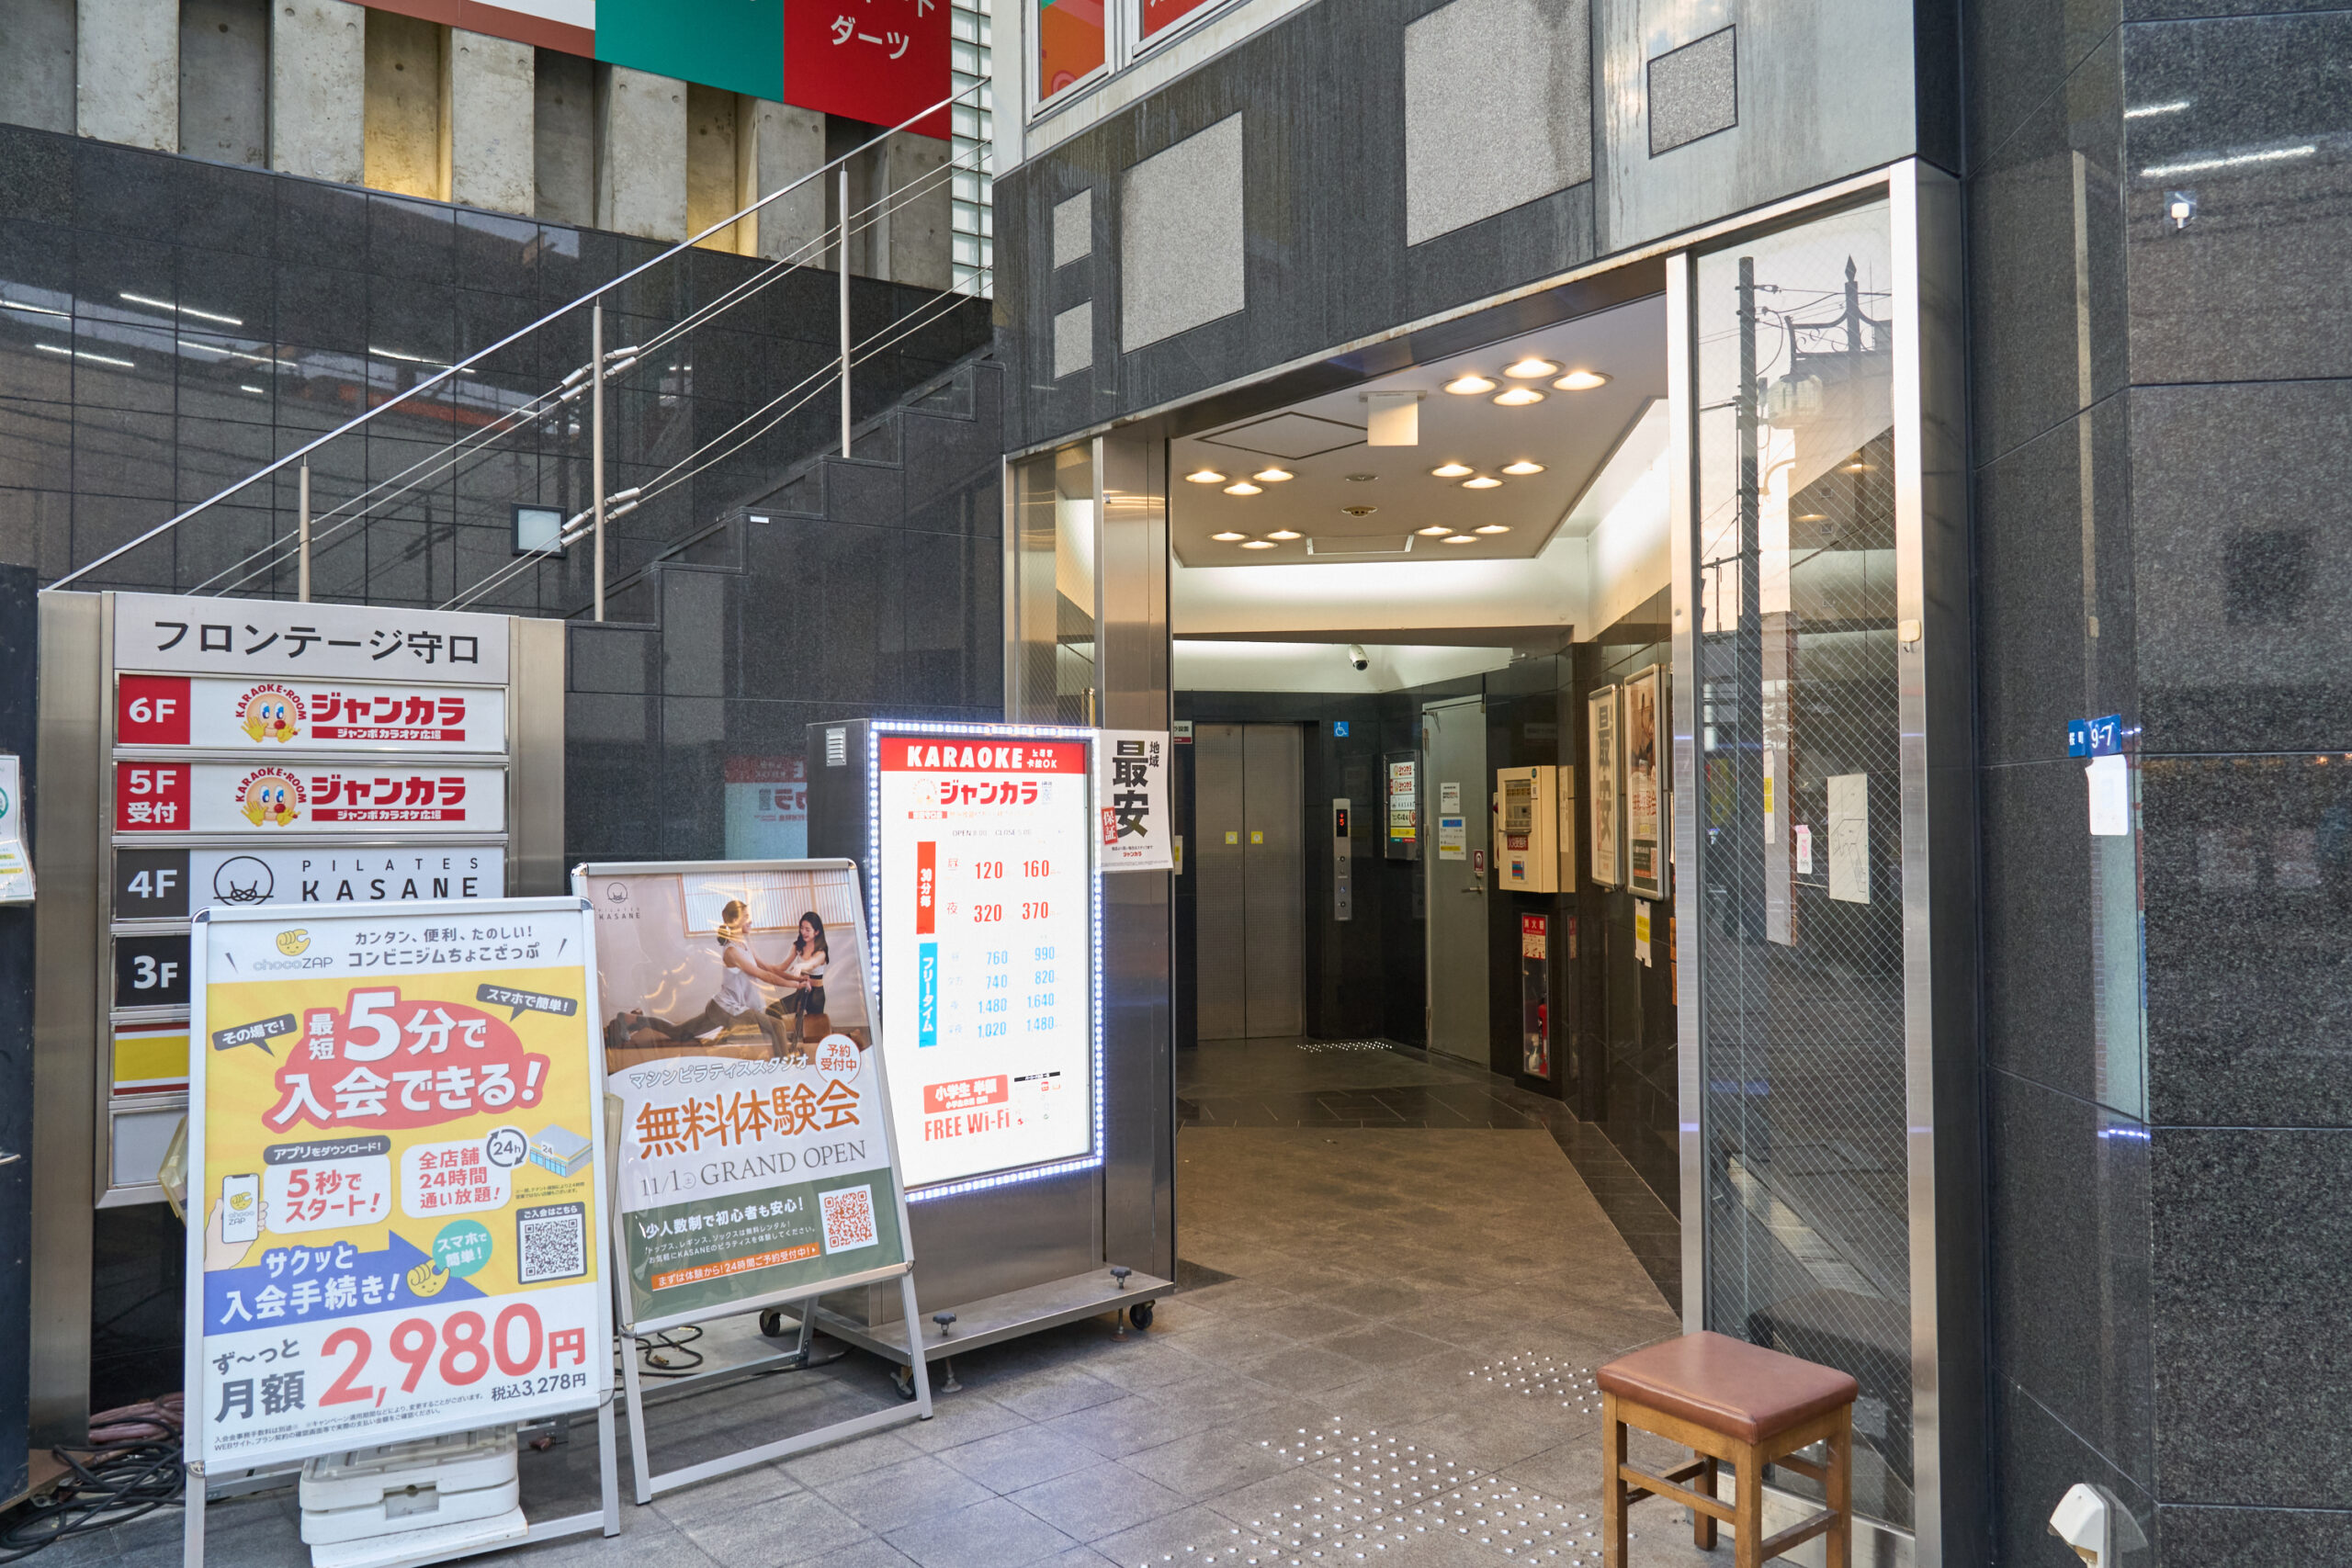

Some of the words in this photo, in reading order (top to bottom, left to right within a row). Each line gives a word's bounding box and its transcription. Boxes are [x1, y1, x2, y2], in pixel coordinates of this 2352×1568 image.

[831, 15, 910, 60] ダーツ
[154, 621, 479, 665] フロンテージ守口
[129, 697, 176, 723] 6F
[311, 692, 466, 726] ジャンカラ
[337, 728, 442, 740] ジャンボカラオケ広場
[2091, 723, 2114, 749] 9-7
[907, 745, 1023, 769] KARAOKE
[1148, 740, 1160, 768] 地域
[129, 770, 177, 795] 5F
[311, 773, 466, 806] ジャンカラ
[940, 779, 1038, 806] ジャンカラ
[1112, 739, 1149, 839] 最安
[127, 801, 177, 823] 受付
[337, 810, 442, 820] ジャンボカラオケ広場
[1102, 809, 1117, 842] 保証
[302, 856, 480, 872] PILATES
[975, 861, 1004, 879] 120
[1023, 860, 1050, 877] 160
[127, 869, 177, 898] 4F
[301, 876, 480, 902] KASANE
[974, 904, 1003, 922] 320
[1022, 902, 1049, 919] 370
[355, 925, 533, 945] カンタン、便利、たのしい！
[253, 956, 334, 972] chocoZAP
[348, 942, 540, 967] コンビニジムちょこざっぷ
[986, 951, 1009, 965] 760
[1035, 946, 1056, 961] 990
[133, 955, 178, 989] 3F
[986, 975, 1008, 990] 740
[1035, 970, 1056, 985] 820
[486, 988, 569, 1013] スマホで簡単！
[922, 956, 934, 1032] フリータイム
[221, 1020, 288, 1045] その場で！
[309, 1013, 335, 1061] 最短
[344, 990, 488, 1063] 5分で
[827, 1043, 851, 1057] 予約
[629, 1054, 809, 1089] マシンピラティススタジオ
[820, 1057, 857, 1072] 受付中
[273, 1060, 543, 1125] 入会できる！
[636, 1078, 861, 1160] 無料体験会
[924, 1116, 963, 1142] FREE
[967, 1108, 1010, 1134] Wi-Fi
[274, 1142, 382, 1160] アプリをダウンロード！
[418, 1146, 481, 1170] 全店舗
[493, 1140, 521, 1156] 24h
[700, 1151, 797, 1186] GRAND
[803, 1139, 866, 1168] OPEN
[287, 1168, 363, 1199] 5秒で
[419, 1168, 488, 1190] 24時間
[285, 1192, 381, 1224] スタート！
[420, 1186, 500, 1210] 通い放題！
[524, 1205, 578, 1219] ご入会はこちら
[645, 1196, 804, 1239] 少人数制で初心者も安心！
[436, 1232, 488, 1253] スマホで
[266, 1246, 354, 1280] サクッと
[446, 1247, 482, 1268] 簡単！
[220, 1273, 400, 1325] 入会手続き！
[318, 1303, 586, 1408] 2,980円
[214, 1371, 305, 1423] 月額
[492, 1371, 587, 1403] 税込3,278円
